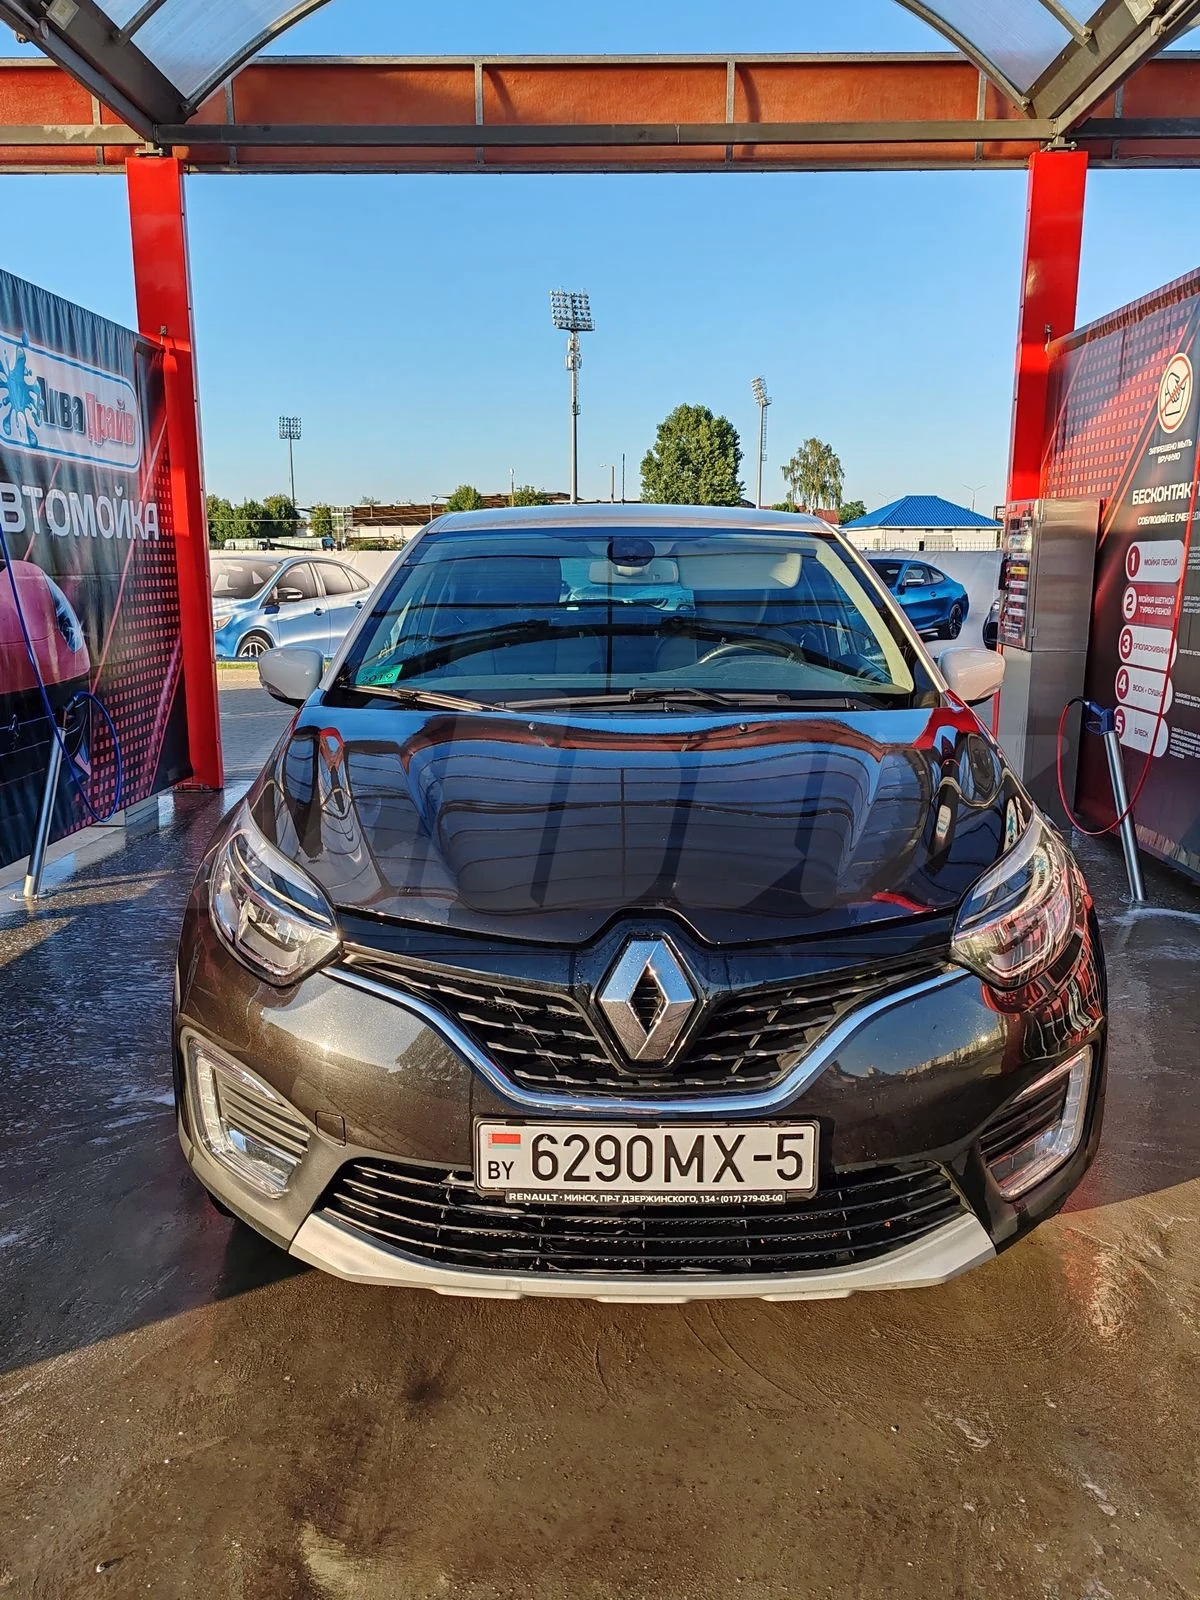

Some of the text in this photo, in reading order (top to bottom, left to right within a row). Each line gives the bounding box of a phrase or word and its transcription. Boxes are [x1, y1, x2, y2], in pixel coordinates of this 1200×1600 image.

[1132, 480, 1200, 506] БЕСКОНТАК
[1130, 552, 1178, 571] 1 МОЙКА ПЕНОЙ
[1126, 593, 1134, 612] 2
[1122, 635, 1131, 653] 3
[1118, 674, 1127, 692] 4
[1132, 684, 1144, 693] ВОСК
[1114, 715, 1123, 733] 5
[488, 1160, 515, 1180] BY
[509, 1193, 559, 1202] RENAULT
[564, 1194, 599, 1203] МИНСК,
[622, 1195, 699, 1204] ДЗЕРЖИНСКОГО,
[700, 1195, 715, 1203] 134
[720, 1195, 741, 1203] (017)
